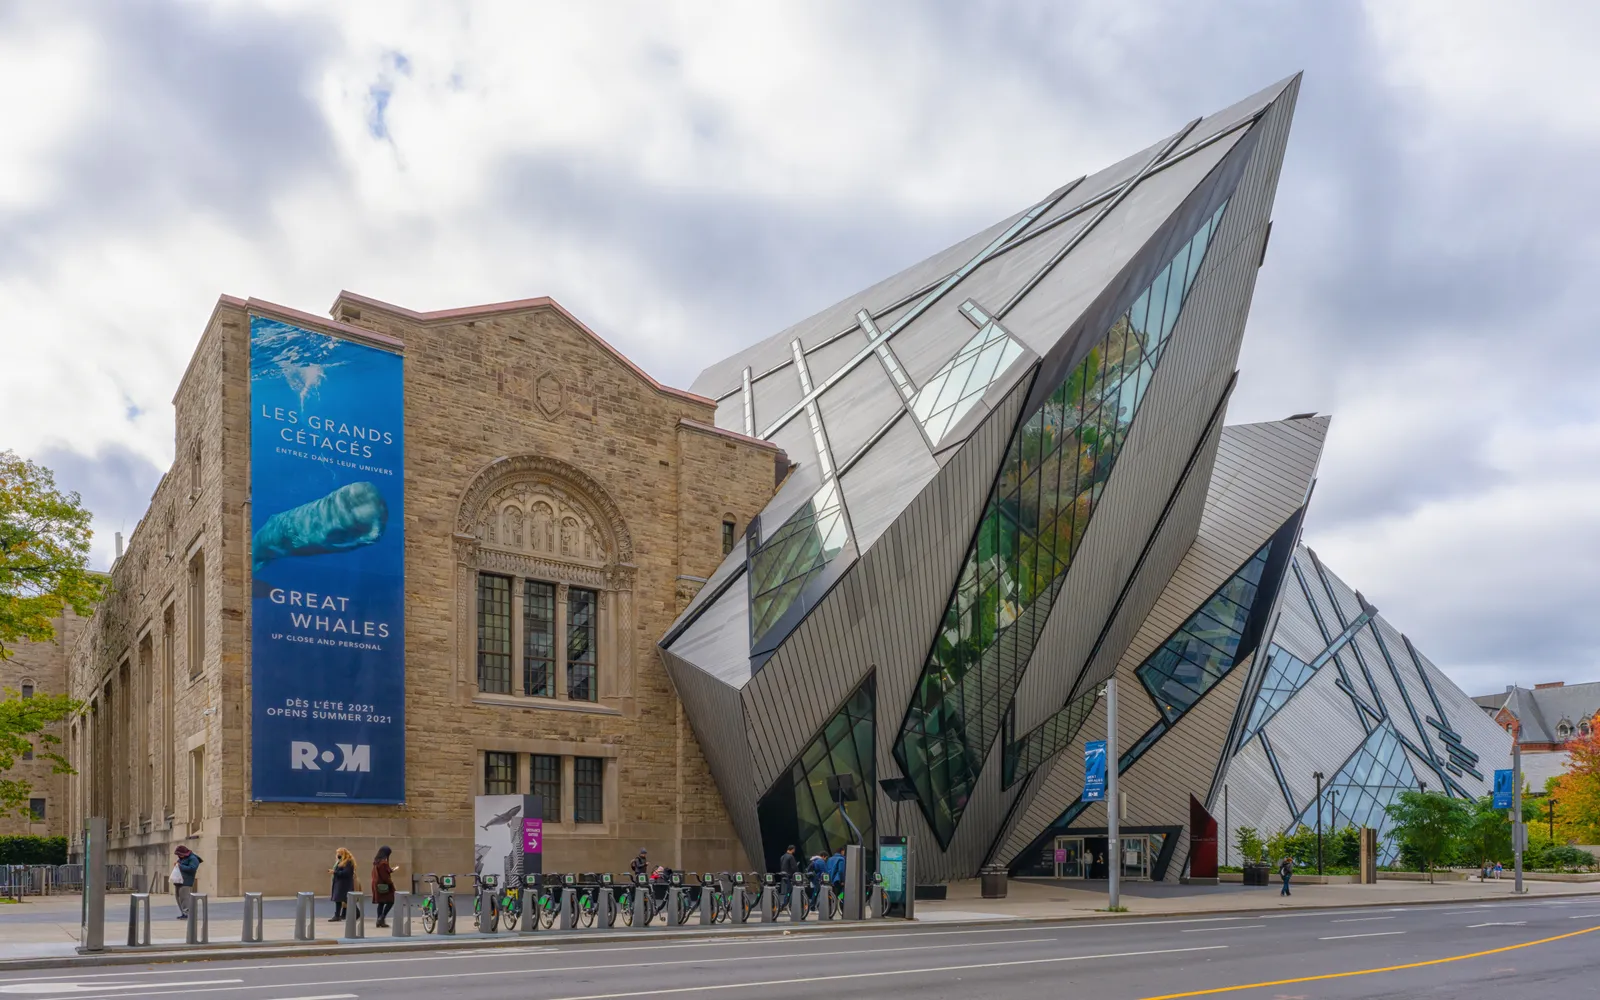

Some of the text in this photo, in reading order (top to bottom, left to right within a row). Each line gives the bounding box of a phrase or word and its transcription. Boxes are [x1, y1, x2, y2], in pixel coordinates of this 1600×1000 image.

[262, 404, 393, 445] LES GRANDS
[280, 427, 372, 458] CÉTACÉS
[276, 447, 393, 476] ENTREZ DANS LEUR UNIVERS
[269, 588, 350, 612] GREAT
[290, 612, 389, 638] WHALES
[286, 634, 314, 644] CLOSE
[317, 638, 336, 646] AND
[338, 640, 382, 651] PERSONAL
[266, 707, 392, 724] OPENS SUMMER 2021
[286, 697, 374, 713] DÈS L'ÉTÉ 2021
